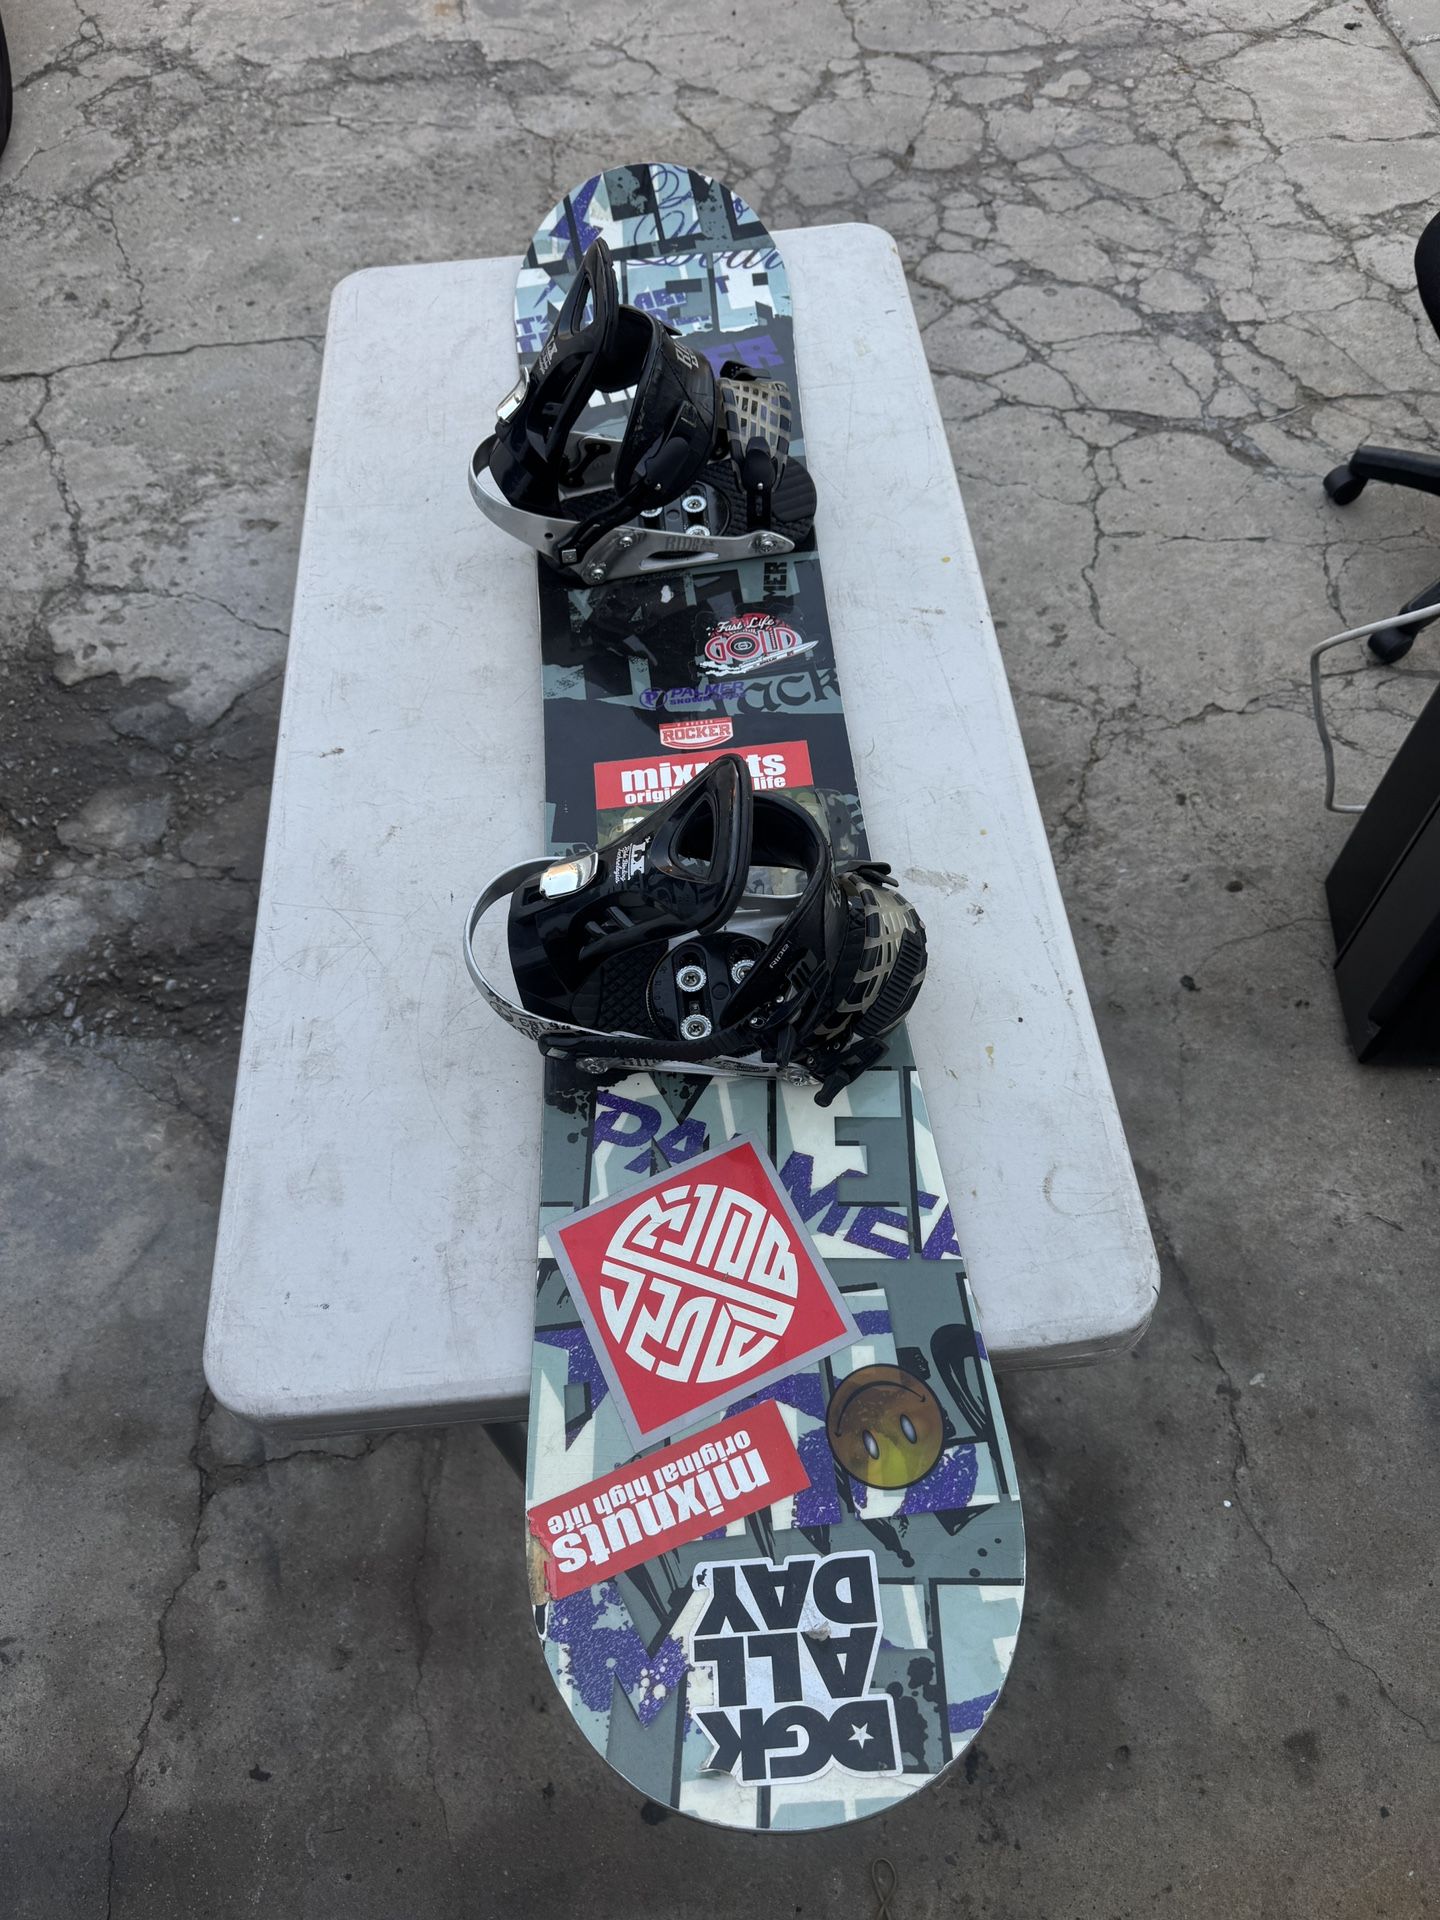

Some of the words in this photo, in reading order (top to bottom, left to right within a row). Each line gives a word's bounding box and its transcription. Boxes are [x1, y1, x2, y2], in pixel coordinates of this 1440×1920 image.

[717, 620, 743, 632] Fast
[747, 614, 775, 629] Life
[704, 626, 803, 664] GOLD
[671, 681, 745, 699] PALMER
[662, 723, 731, 742] ROCKER
[621, 754, 786, 793] mixts
[753, 775, 786, 790] life
[652, 1429, 752, 1480] original
[552, 1447, 770, 1574] mixnuts
[594, 1469, 652, 1516] high
[547, 1503, 592, 1535] life
[695, 1556, 877, 1637] DAY
[694, 1627, 877, 1707] ALL
[695, 1699, 898, 1782] DGK
